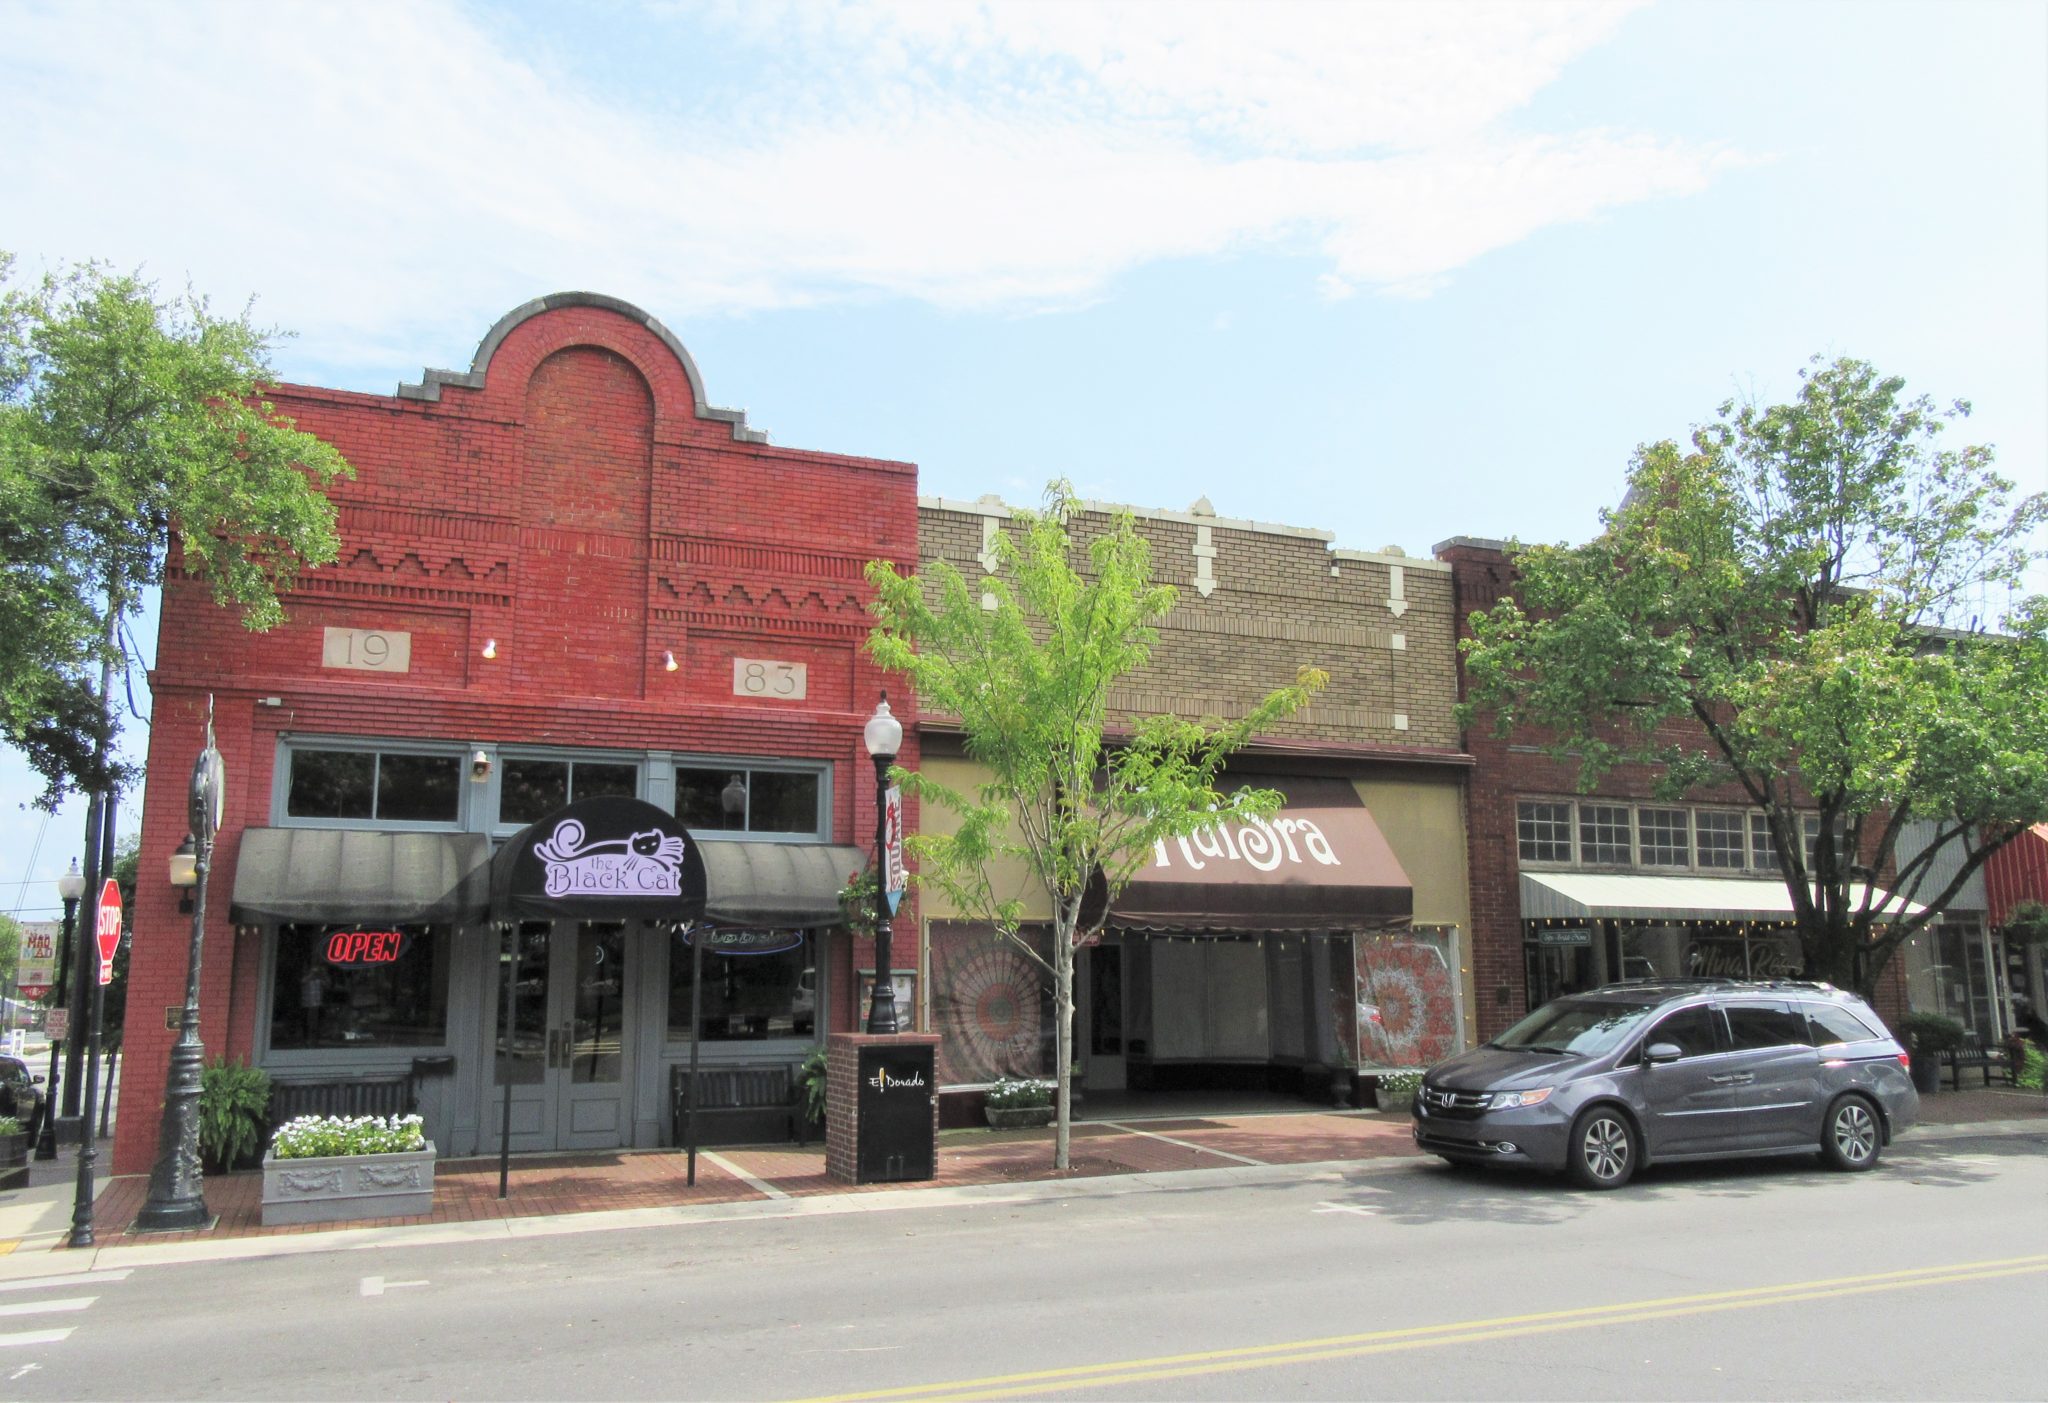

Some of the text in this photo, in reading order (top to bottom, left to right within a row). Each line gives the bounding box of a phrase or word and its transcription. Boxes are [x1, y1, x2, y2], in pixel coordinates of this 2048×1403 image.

[345, 633, 390, 667] 19
[744, 663, 796, 695] 83
[591, 856, 613, 871] the
[548, 863, 679, 895] Black Cat
[99, 906, 121, 936] STOP
[327, 932, 401, 962] OPEN
[885, 1070, 925, 1088] Dorado
